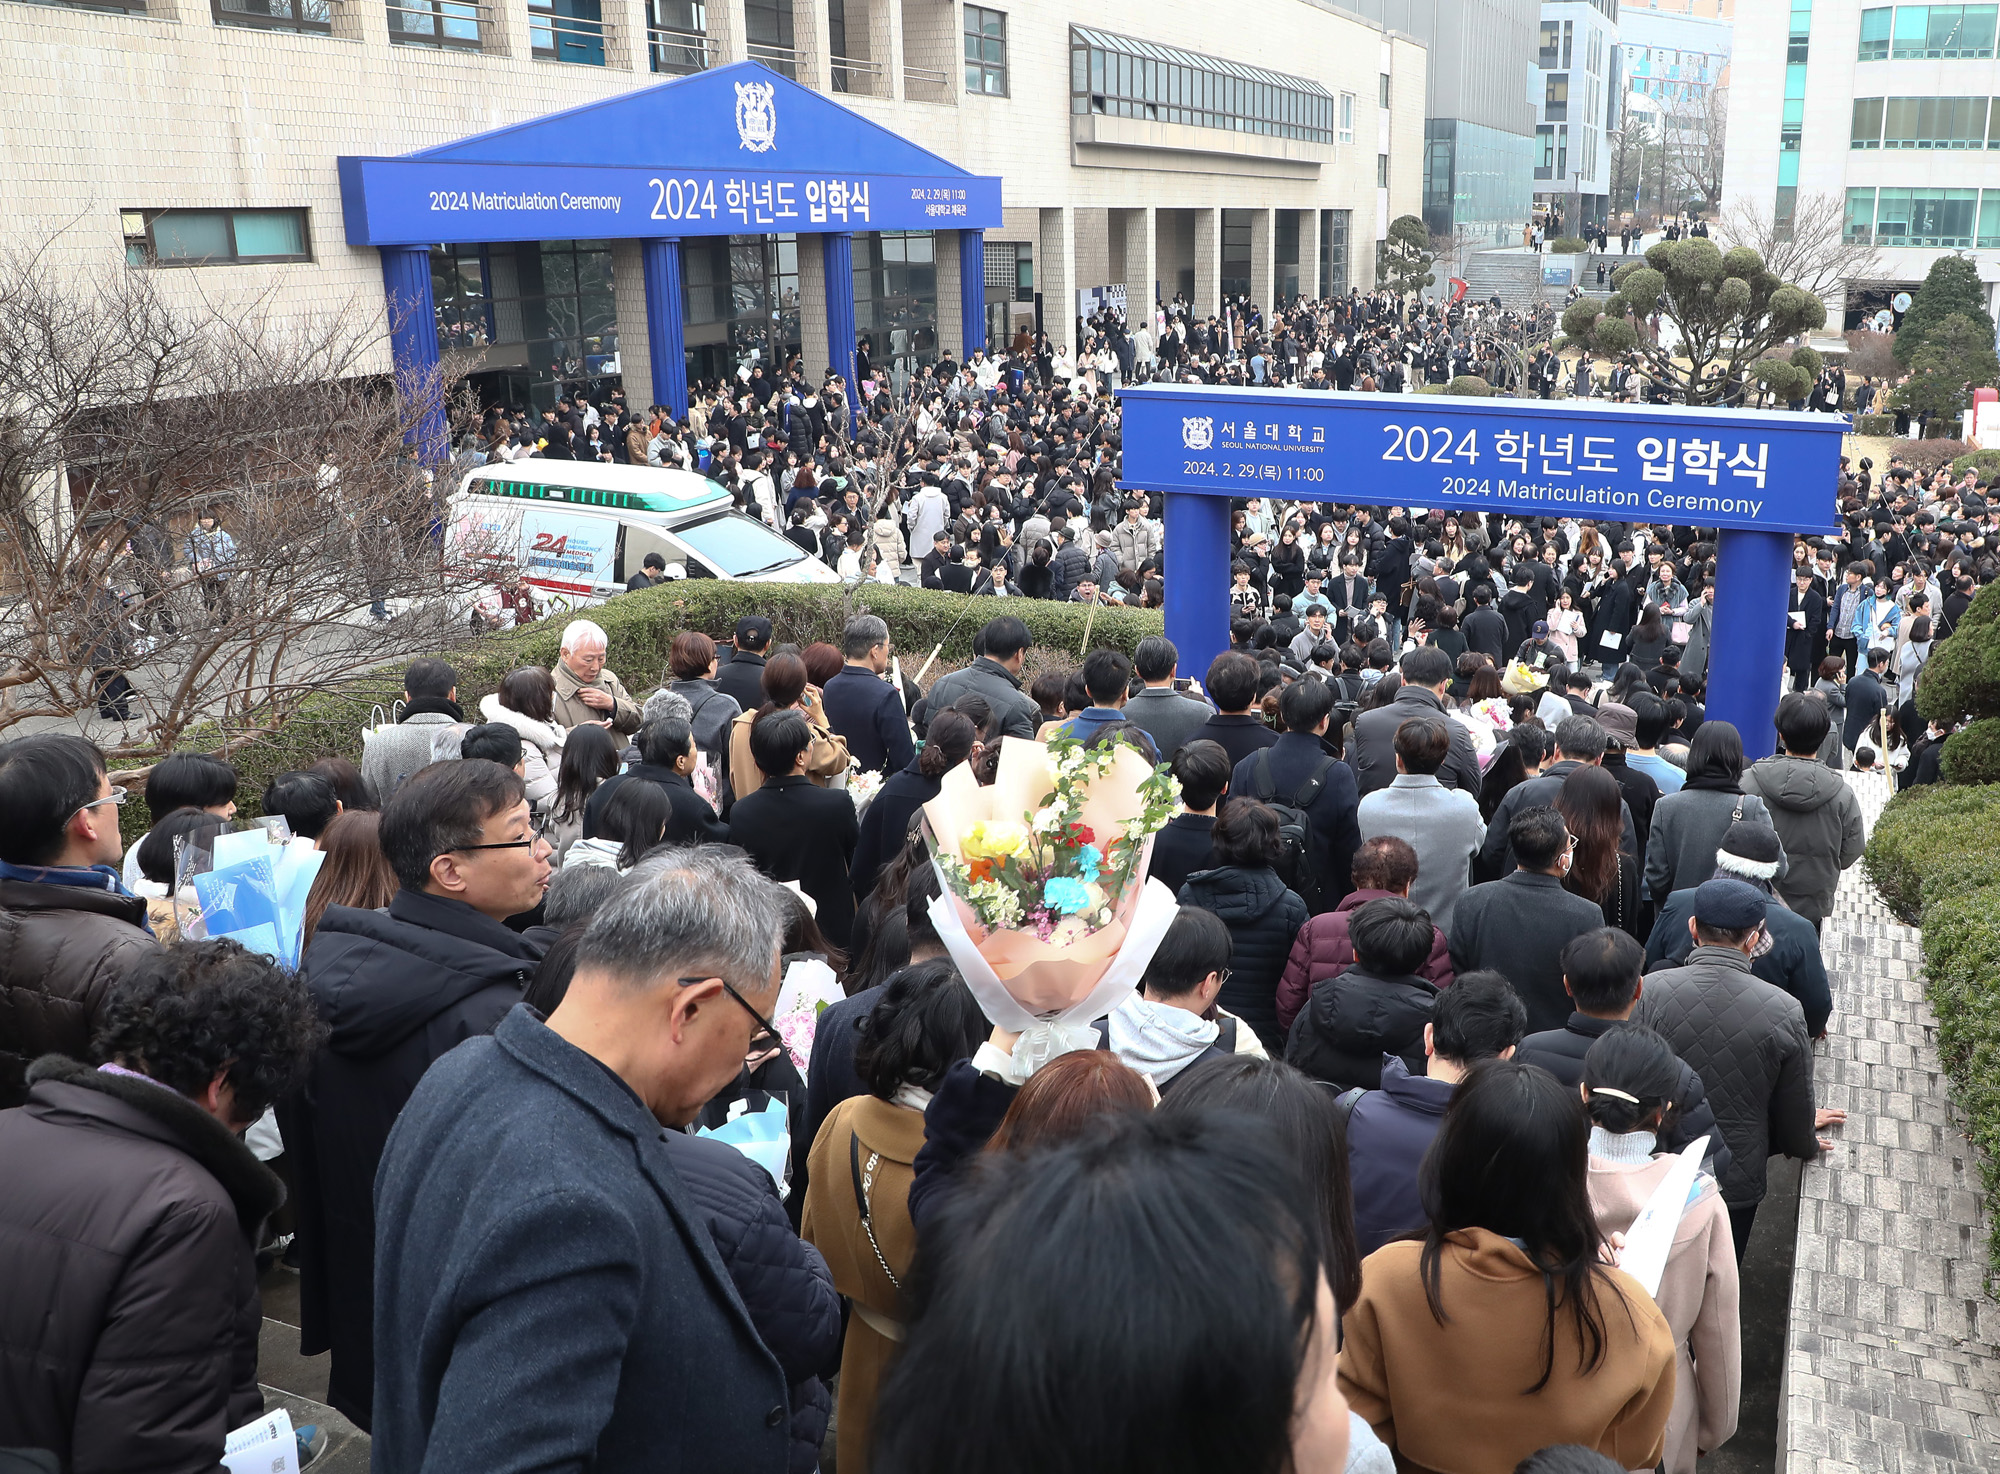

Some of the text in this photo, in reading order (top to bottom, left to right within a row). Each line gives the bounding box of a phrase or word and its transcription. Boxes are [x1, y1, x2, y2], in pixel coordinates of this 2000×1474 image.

[429, 191, 621, 214] 2024 Matriculation Ceremony
[649, 178, 870, 225] 2024 학년도 입학식
[952, 189, 966, 200] 11:00
[925, 204, 967, 217] 서울대학교 체육관
[1221, 421, 1326, 443] 서울대학교
[1221, 441, 1325, 453] SEOUL NATIONAL UNIVERSITY
[1382, 424, 1769, 489] 2024 학년도 입학식
[1183, 460, 1219, 477] 2024.
[1222, 462, 1235, 478] 2.
[1287, 466, 1325, 482] 11:00
[1441, 476, 1763, 519] 2024 Matriculation Ceremony
[531, 532, 568, 558] 24
[565, 544, 603, 553] EMERGENCY
[566, 549, 593, 557] MEDICAL
